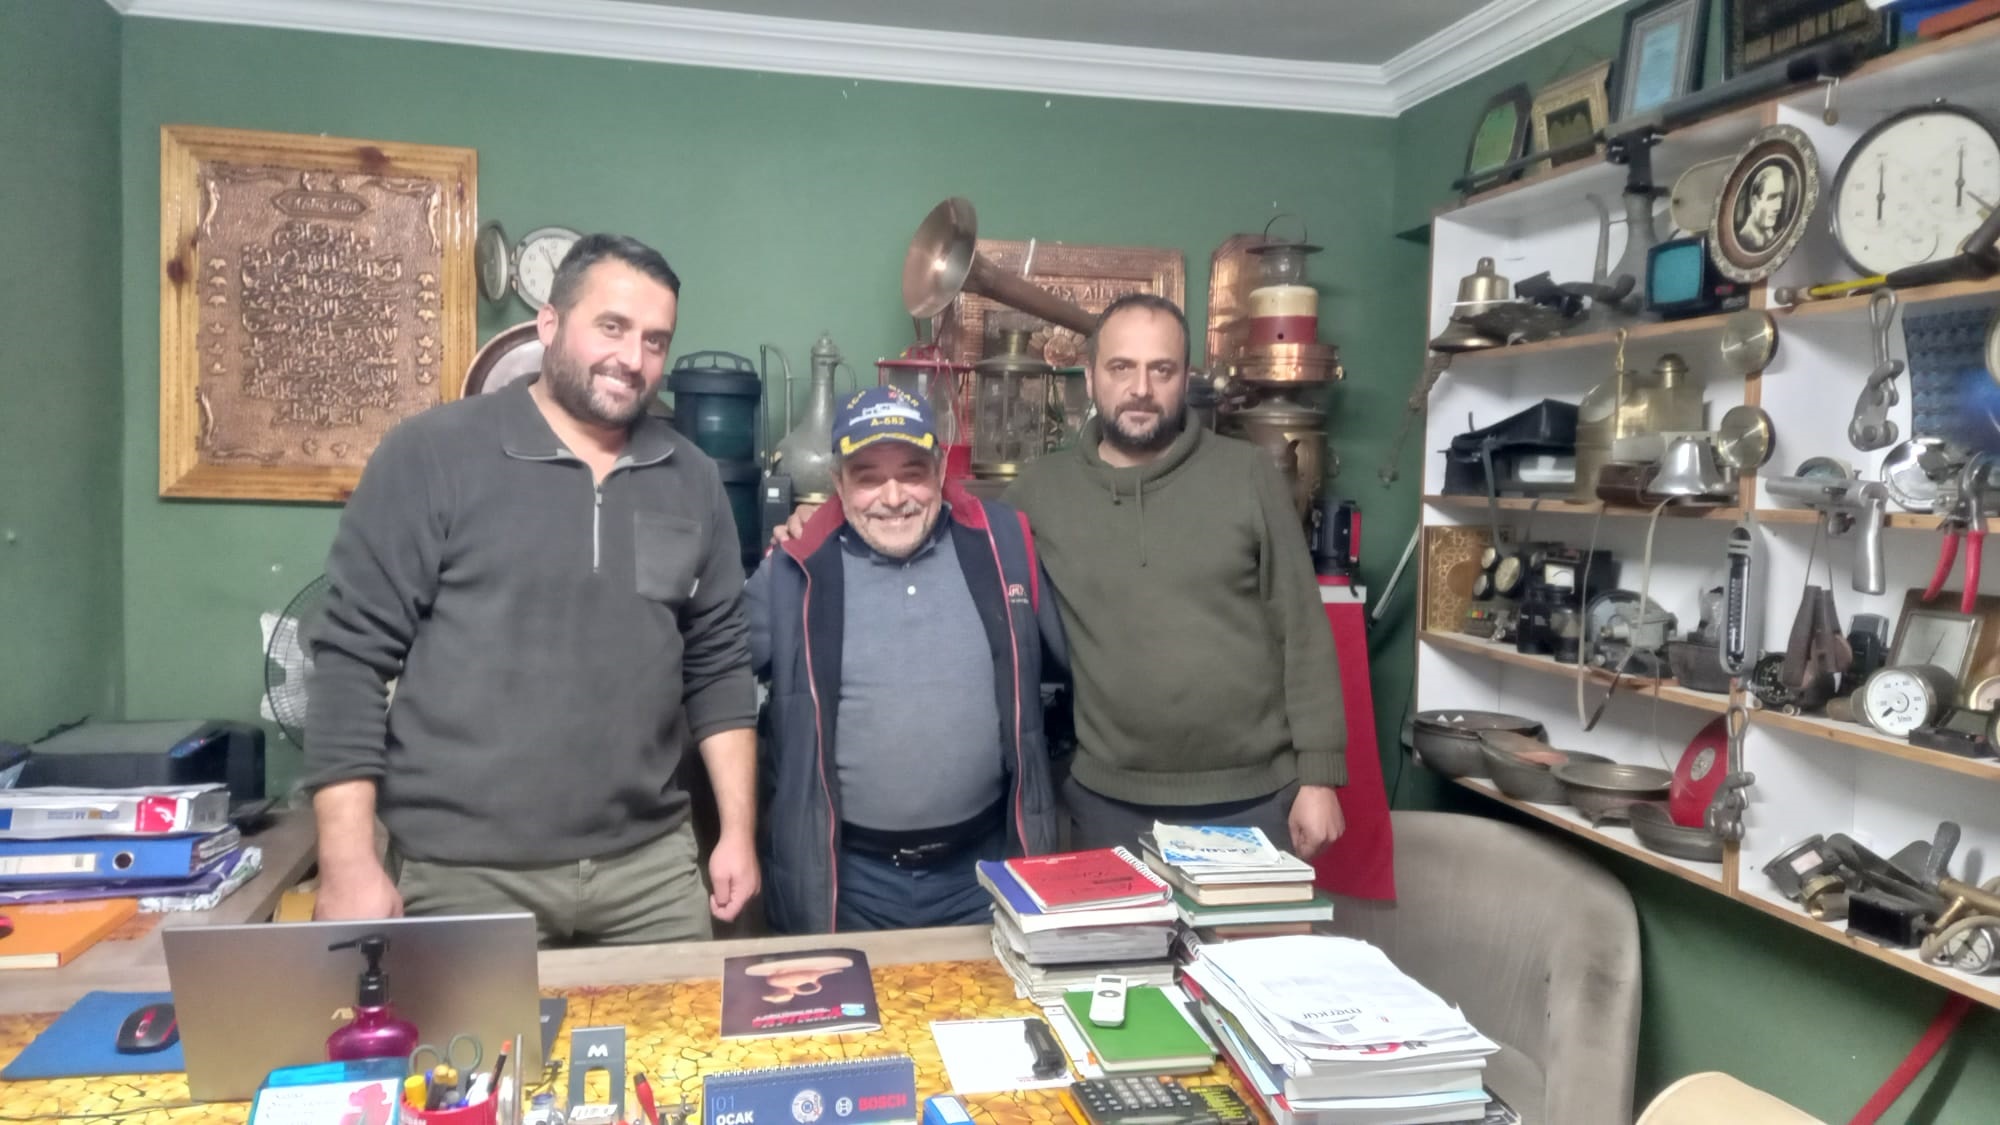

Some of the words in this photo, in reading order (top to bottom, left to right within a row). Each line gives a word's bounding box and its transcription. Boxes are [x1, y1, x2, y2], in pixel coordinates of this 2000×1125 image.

[715, 1096, 735, 1111] 01
[858, 1094, 907, 1111] BOSCH
[715, 1111, 755, 1125] OCAK
